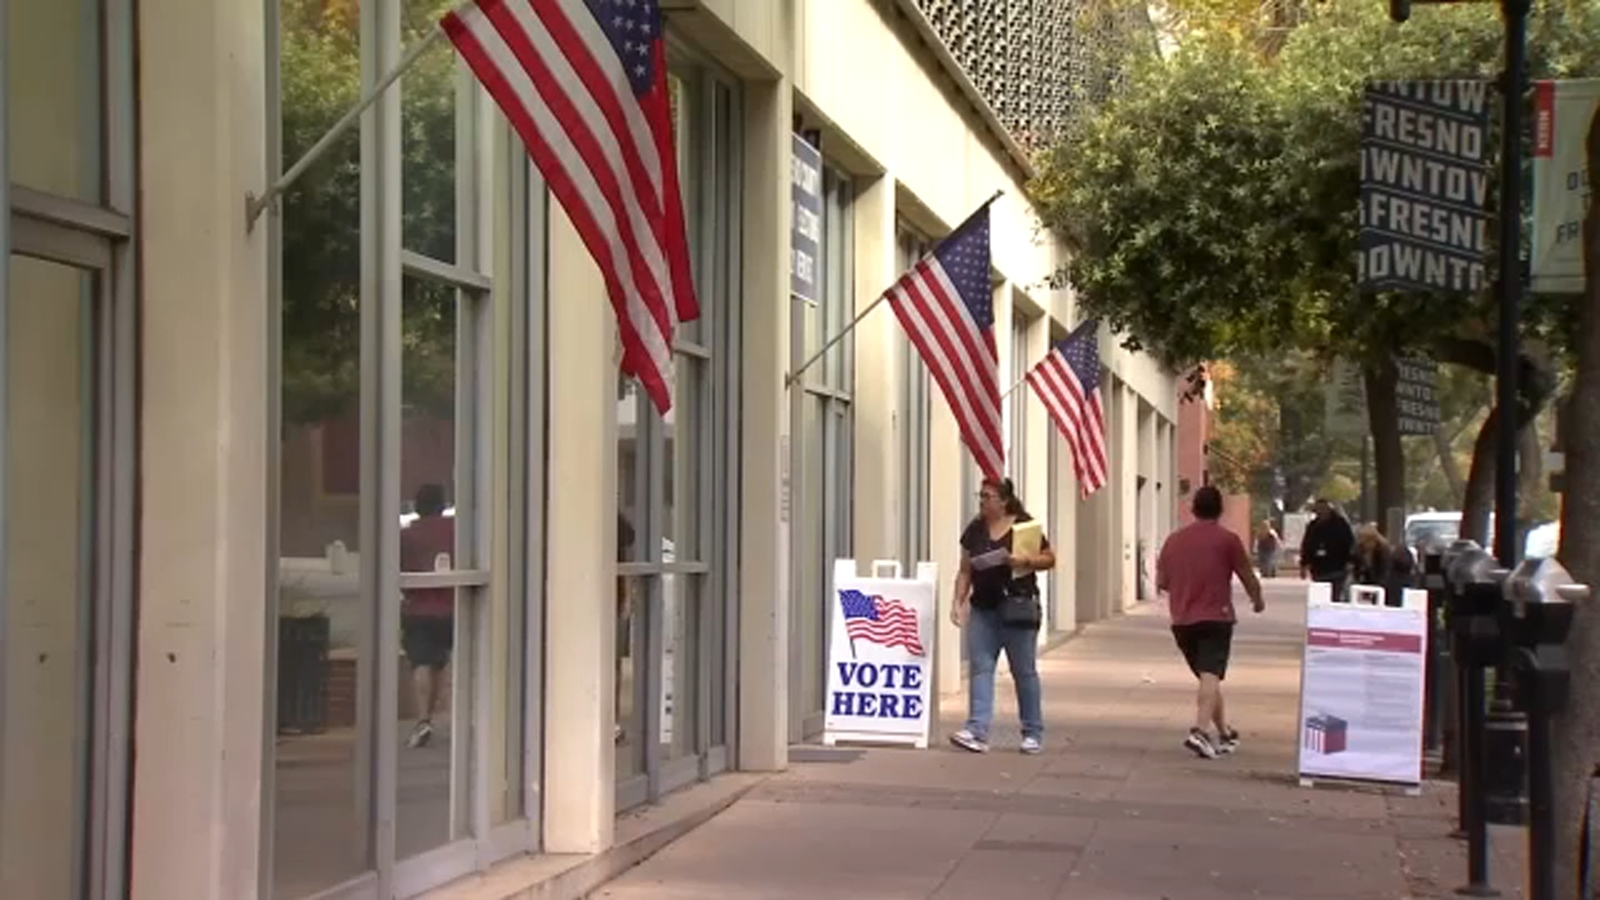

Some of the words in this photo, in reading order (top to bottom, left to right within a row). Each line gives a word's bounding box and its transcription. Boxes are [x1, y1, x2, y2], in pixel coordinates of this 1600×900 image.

[1360, 147, 1486, 206] WNTO
[1358, 242, 1485, 292] OWNT
[837, 662, 921, 689] VOTE
[831, 692, 923, 719] HERE
